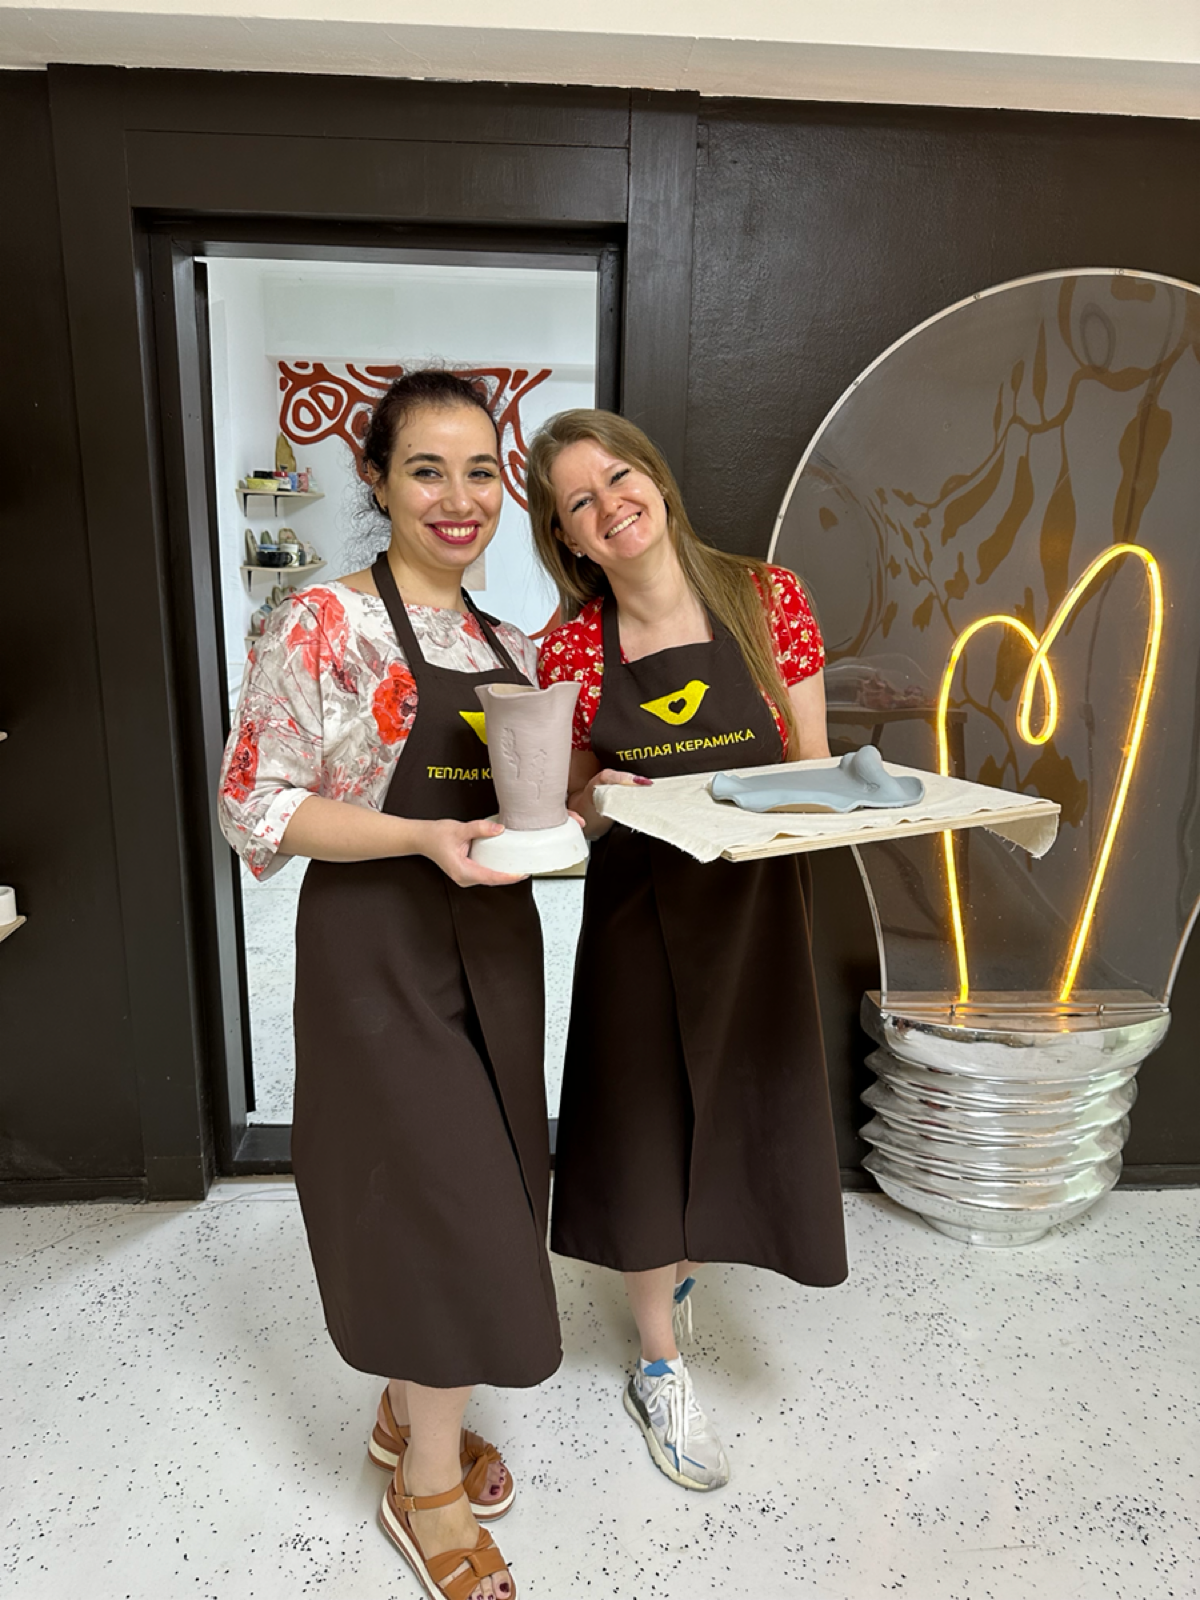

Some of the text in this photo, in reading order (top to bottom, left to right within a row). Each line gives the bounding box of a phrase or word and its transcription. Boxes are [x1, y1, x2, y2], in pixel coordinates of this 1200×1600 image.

[616, 728, 756, 762] ТЕПЛАЯ КЕРАМИКА
[426, 765, 493, 780] ТЕПЛАЯ К
